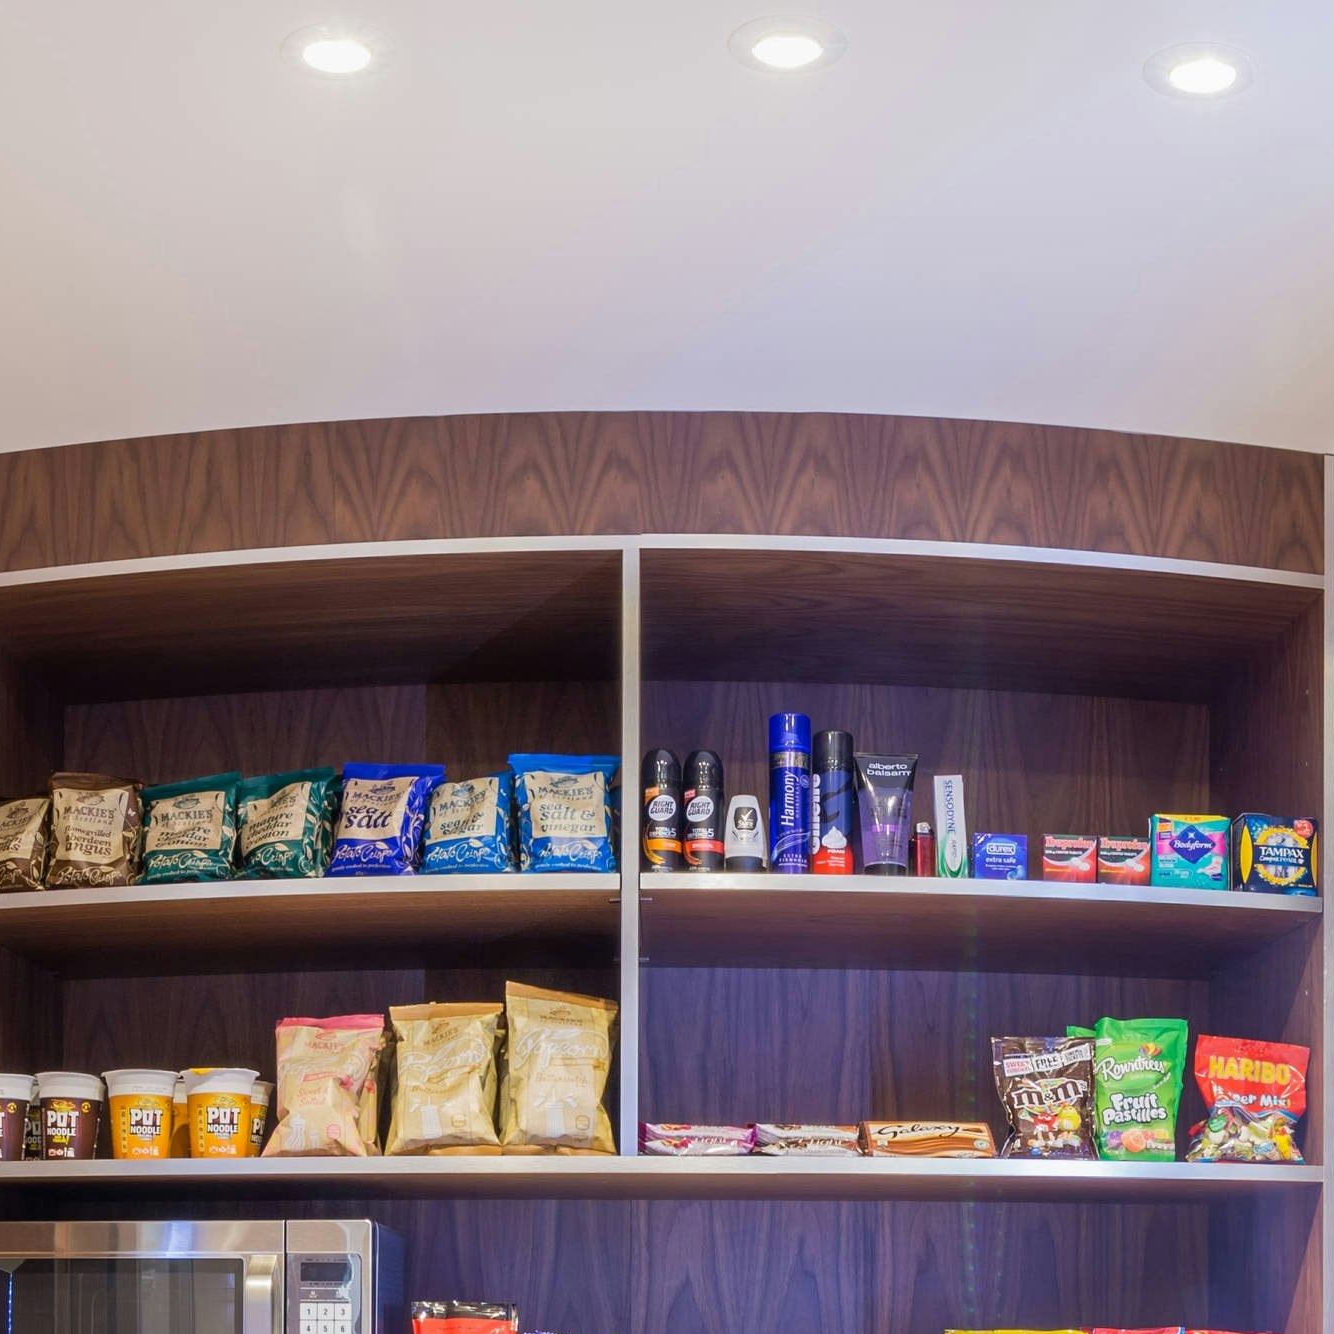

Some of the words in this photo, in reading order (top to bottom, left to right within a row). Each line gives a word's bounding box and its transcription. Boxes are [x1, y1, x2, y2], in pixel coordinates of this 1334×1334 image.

[867, 769, 912, 777] balsam
[352, 792, 404, 801] MACKIE'S
[538, 786, 595, 796] MACKIE'S
[780, 770, 799, 826] Harmony
[348, 805, 378, 814] sea
[540, 802, 562, 811] sea
[650, 806, 673, 815] GUARD
[653, 801, 673, 809] RIGHT
[690, 801, 711, 810] RIGHT
[944, 779, 956, 834] SENSODYNE
[63, 807, 117, 818] MACKIE'S
[160, 809, 213, 821] MACKIE'S
[540, 808, 578, 821] salt
[687, 807, 711, 816] GUARD
[344, 811, 393, 830] salt
[540, 823, 596, 834] vinegar
[1045, 836, 1094, 849] Ibuprofen
[1100, 838, 1149, 850] Ibuprofen
[1174, 839, 1213, 851] Bodyform
[65, 842, 112, 856] angus
[988, 845, 1014, 854] durex
[1259, 847, 1304, 858] TAMPAX
[514, 1028, 608, 1070] Popcorn
[1035, 1057, 1058, 1069] FREE
[1208, 1055, 1291, 1085] HARIBO
[1012, 1080, 1087, 1109] m&m's
[1110, 1093, 1158, 1111] Fruit
[47, 1110, 79, 1128] POT
[130, 1109, 163, 1125] POT
[207, 1106, 241, 1124] POT
[1102, 1106, 1167, 1125] Pastilles
[47, 1128, 76, 1136] NOODLE
[130, 1125, 161, 1135] NOODLE
[207, 1124, 238, 1133] NOODLE
[876, 1123, 963, 1138] Galaxy
